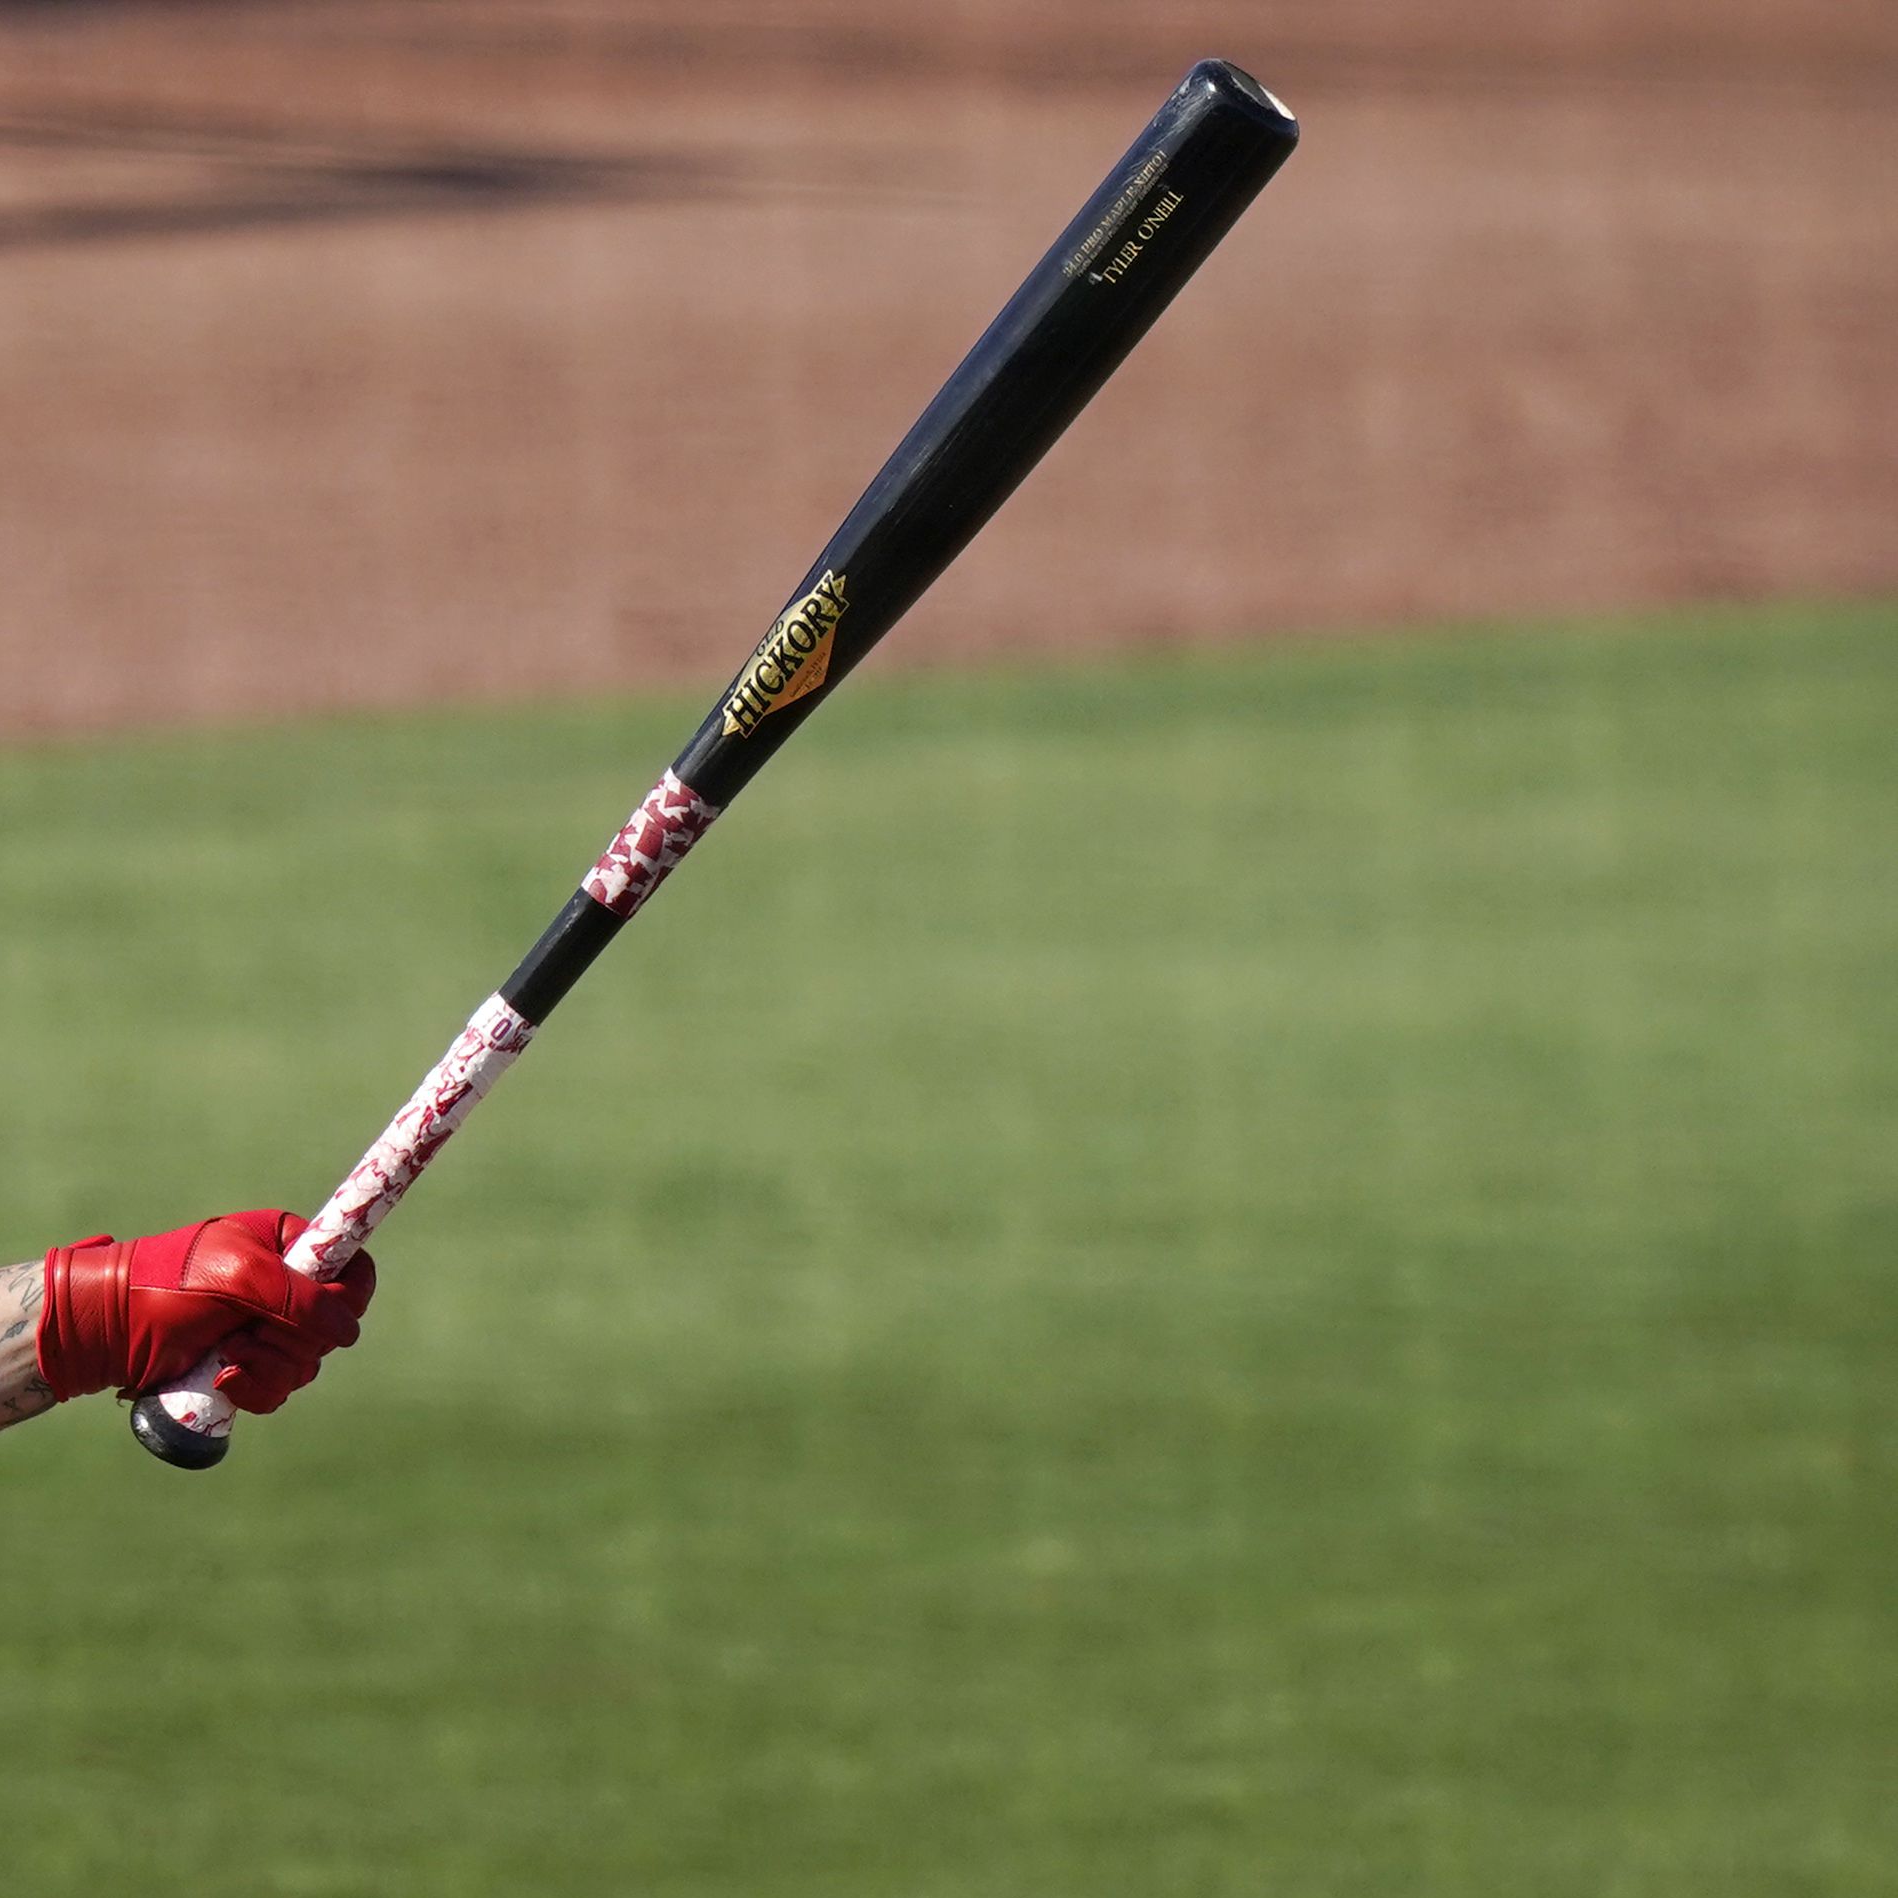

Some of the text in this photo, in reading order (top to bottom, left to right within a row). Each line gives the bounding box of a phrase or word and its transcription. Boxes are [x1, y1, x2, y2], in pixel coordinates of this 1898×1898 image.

[1081, 228, 1103, 254] PRO
[1102, 241, 1144, 284] TYLER
[1138, 190, 1184, 241] O'NEILL
[726, 575, 848, 735] HICKORY
